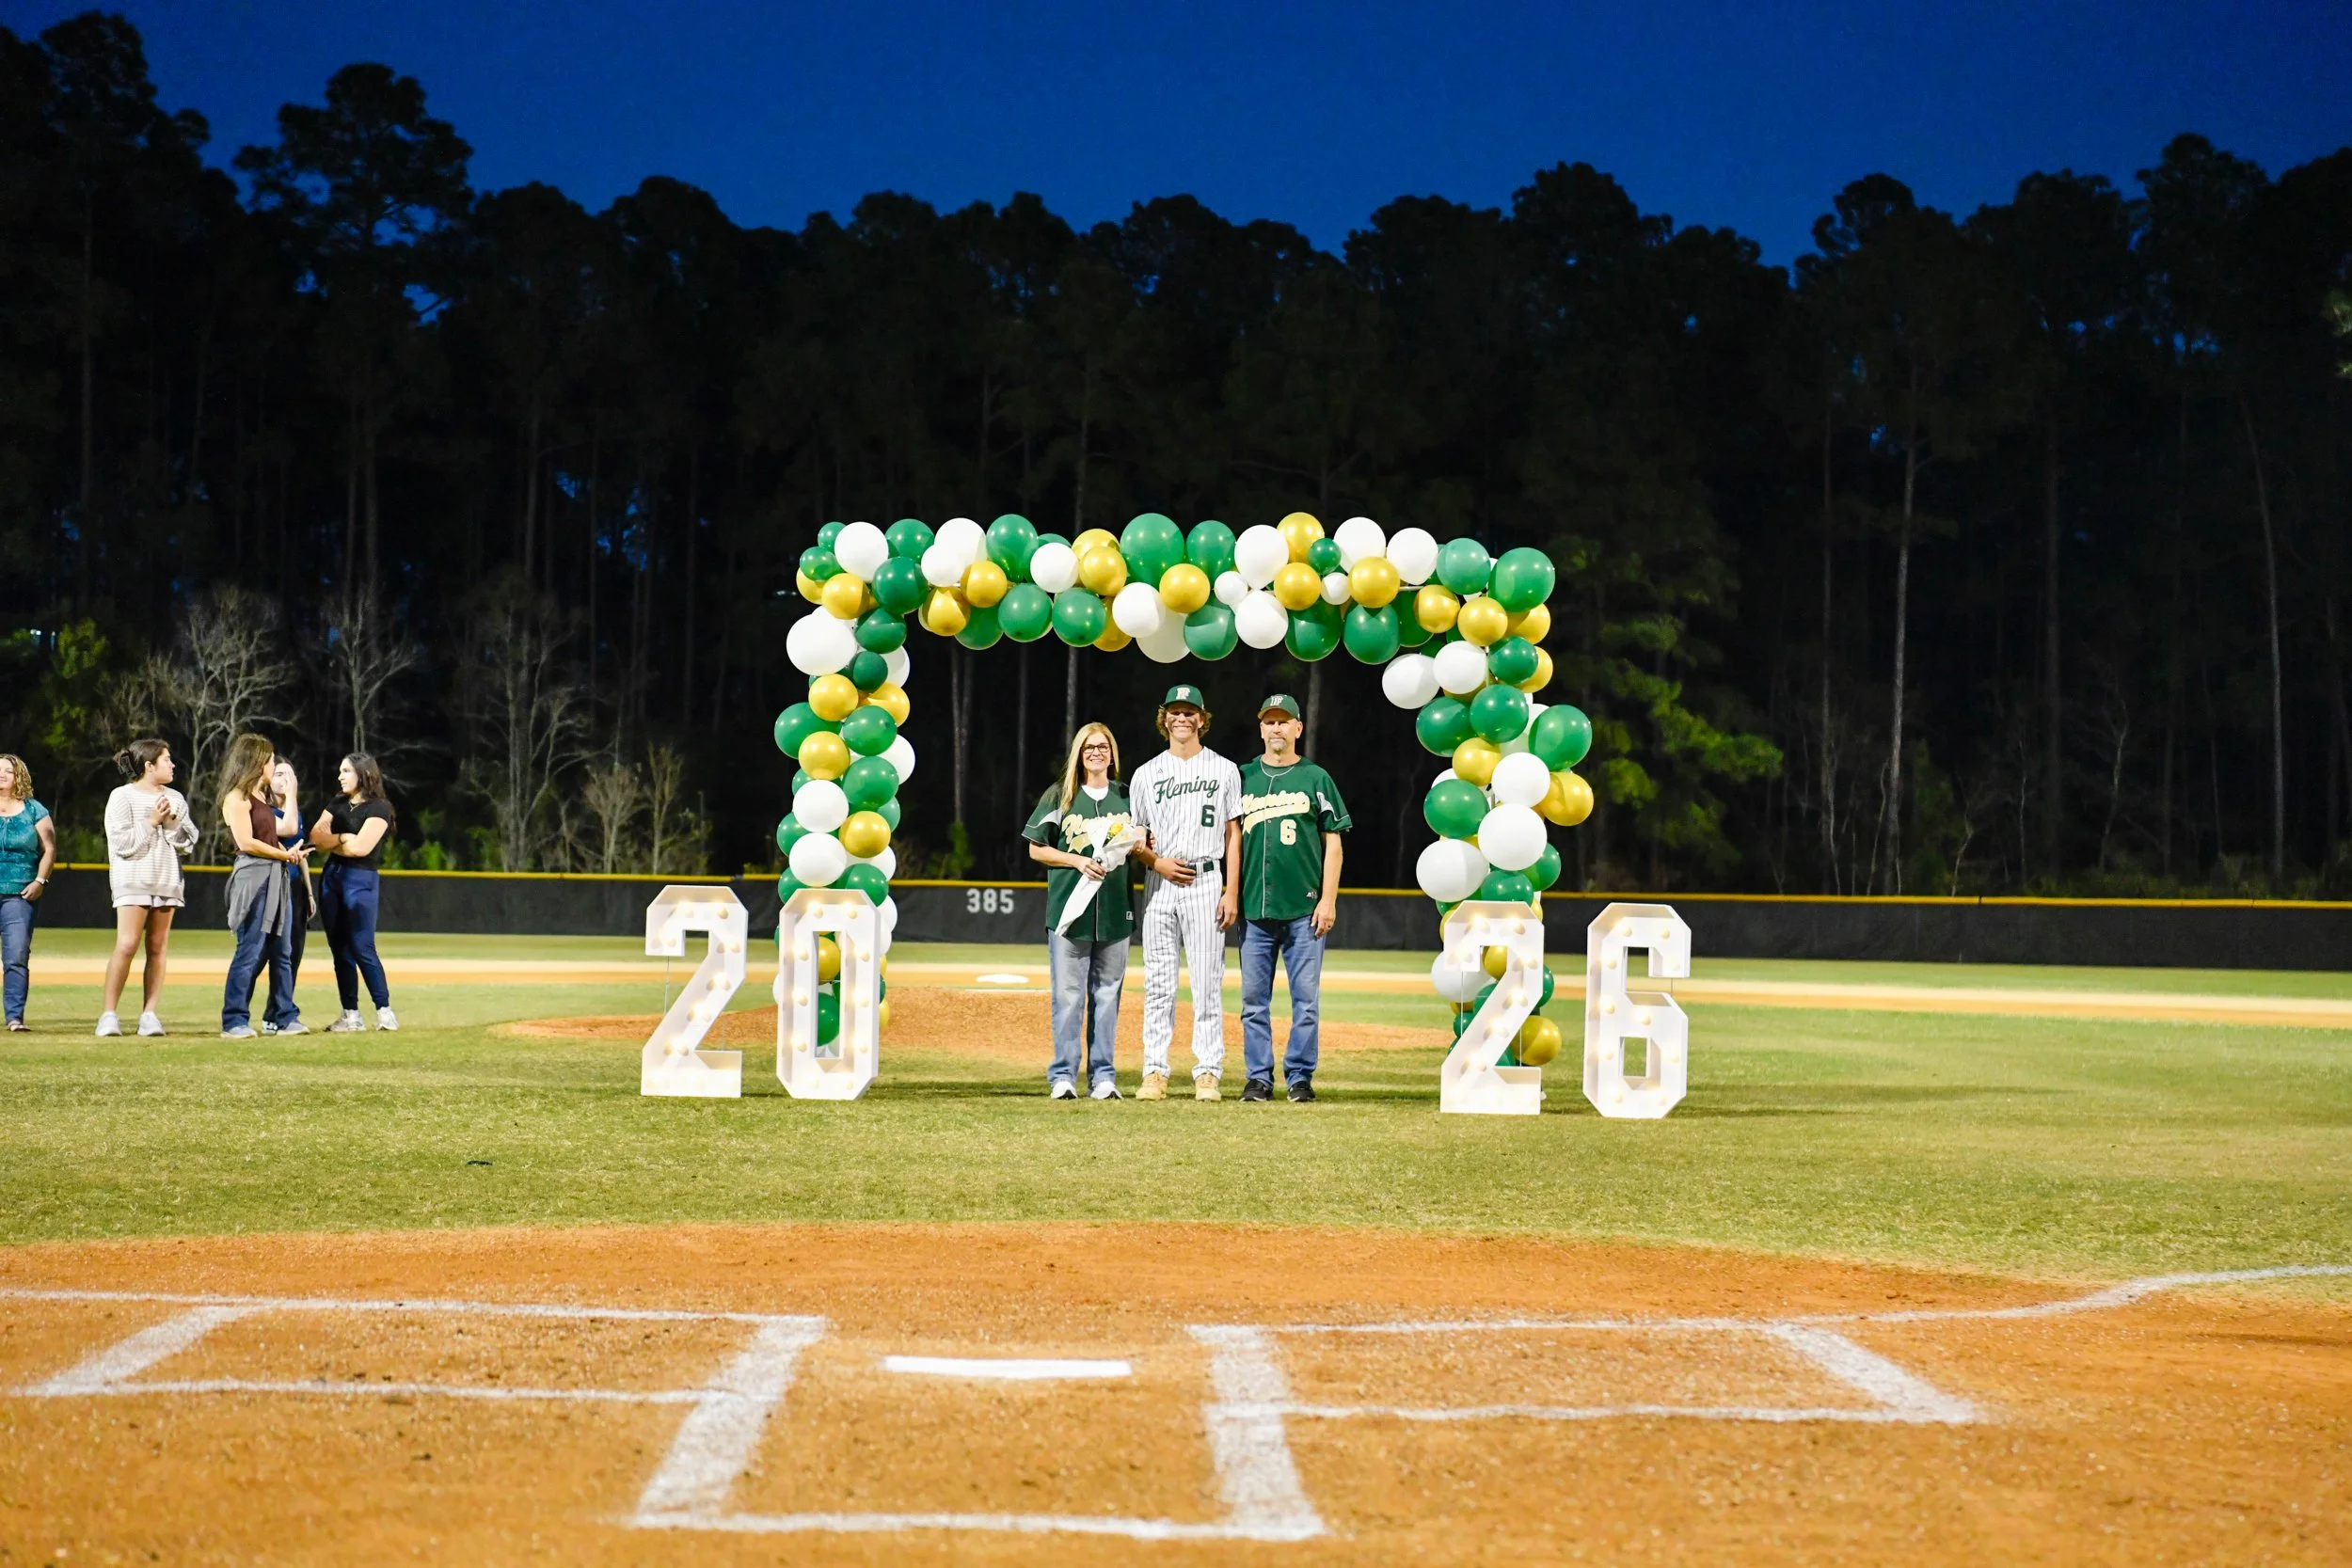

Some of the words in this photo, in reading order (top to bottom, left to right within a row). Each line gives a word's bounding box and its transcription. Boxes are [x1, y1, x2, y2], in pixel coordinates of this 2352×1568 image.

[1152, 775, 1220, 804] Fleming
[1200, 804, 1216, 828] 6
[1280, 818, 1296, 846] 6
[966, 887, 1014, 914] 385
